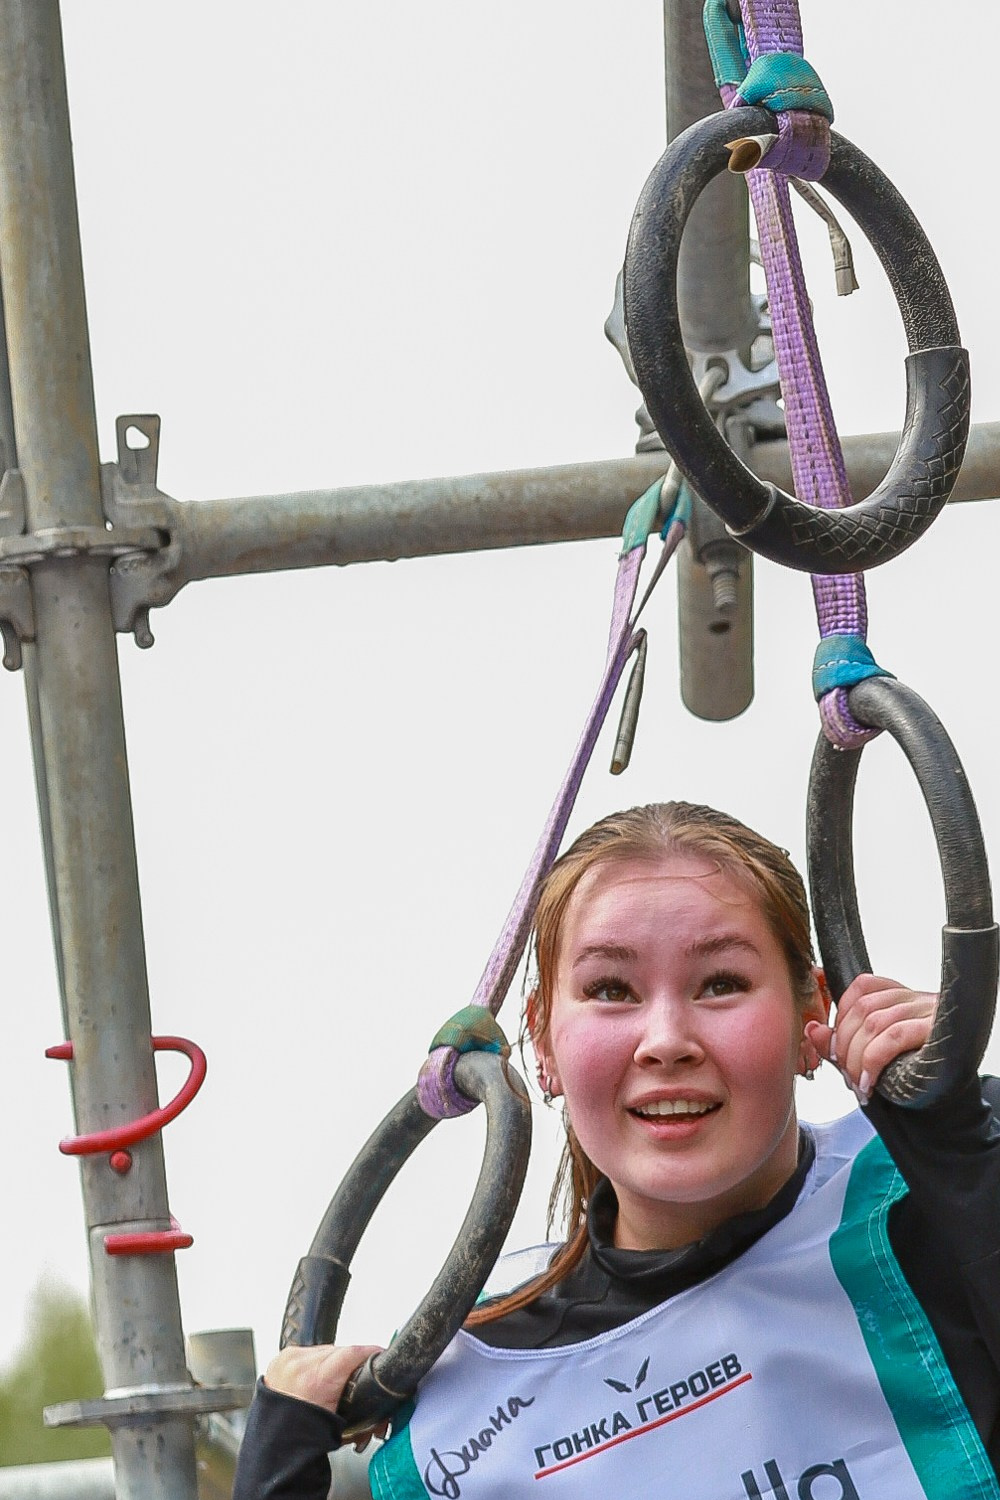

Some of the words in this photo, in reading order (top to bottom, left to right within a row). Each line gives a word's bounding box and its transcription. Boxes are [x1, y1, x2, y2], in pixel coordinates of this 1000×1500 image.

[424, 1396, 536, 1500] Диана
[534, 1411, 632, 1468] ГОНКА
[636, 1353, 742, 1422] ГЕРОЕВ
